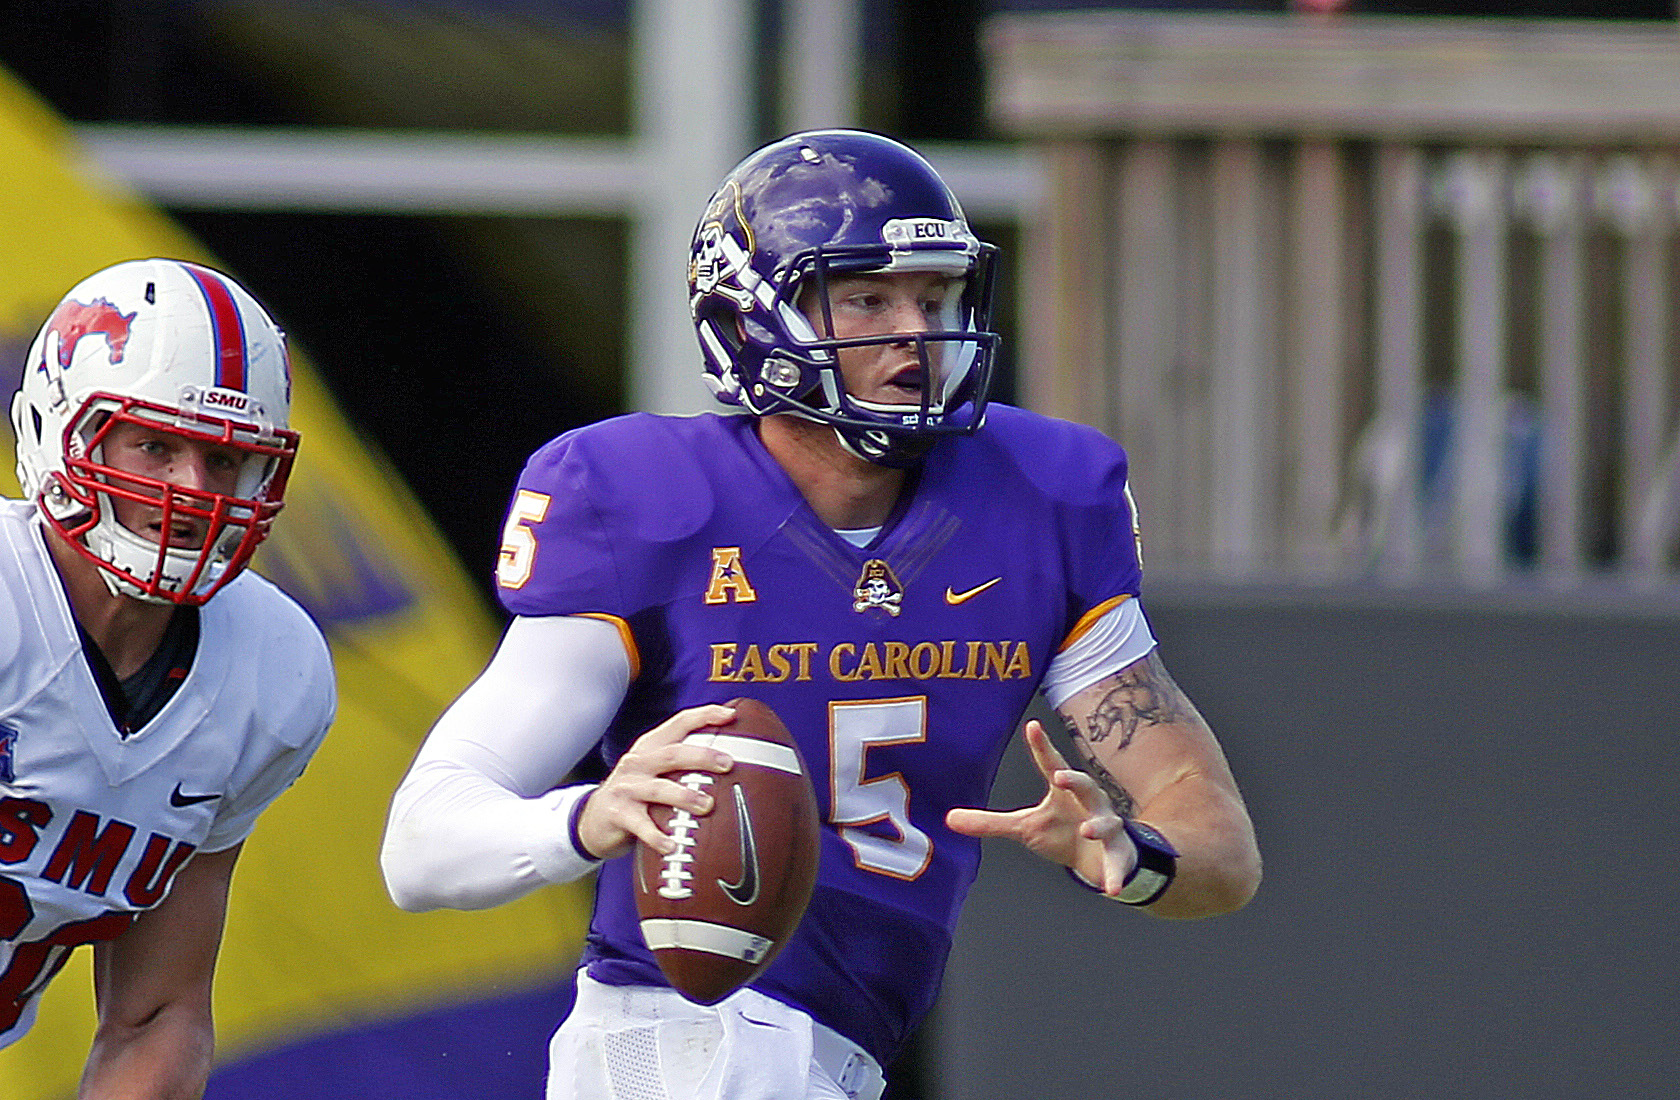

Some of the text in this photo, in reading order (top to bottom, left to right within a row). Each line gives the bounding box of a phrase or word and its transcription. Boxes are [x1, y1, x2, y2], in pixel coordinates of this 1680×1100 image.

[914, 222, 946, 239] ECU
[205, 391, 248, 410] SMU
[496, 488, 552, 590] 5
[707, 640, 1033, 683] EAST CAROLINA
[827, 694, 934, 882] 5
